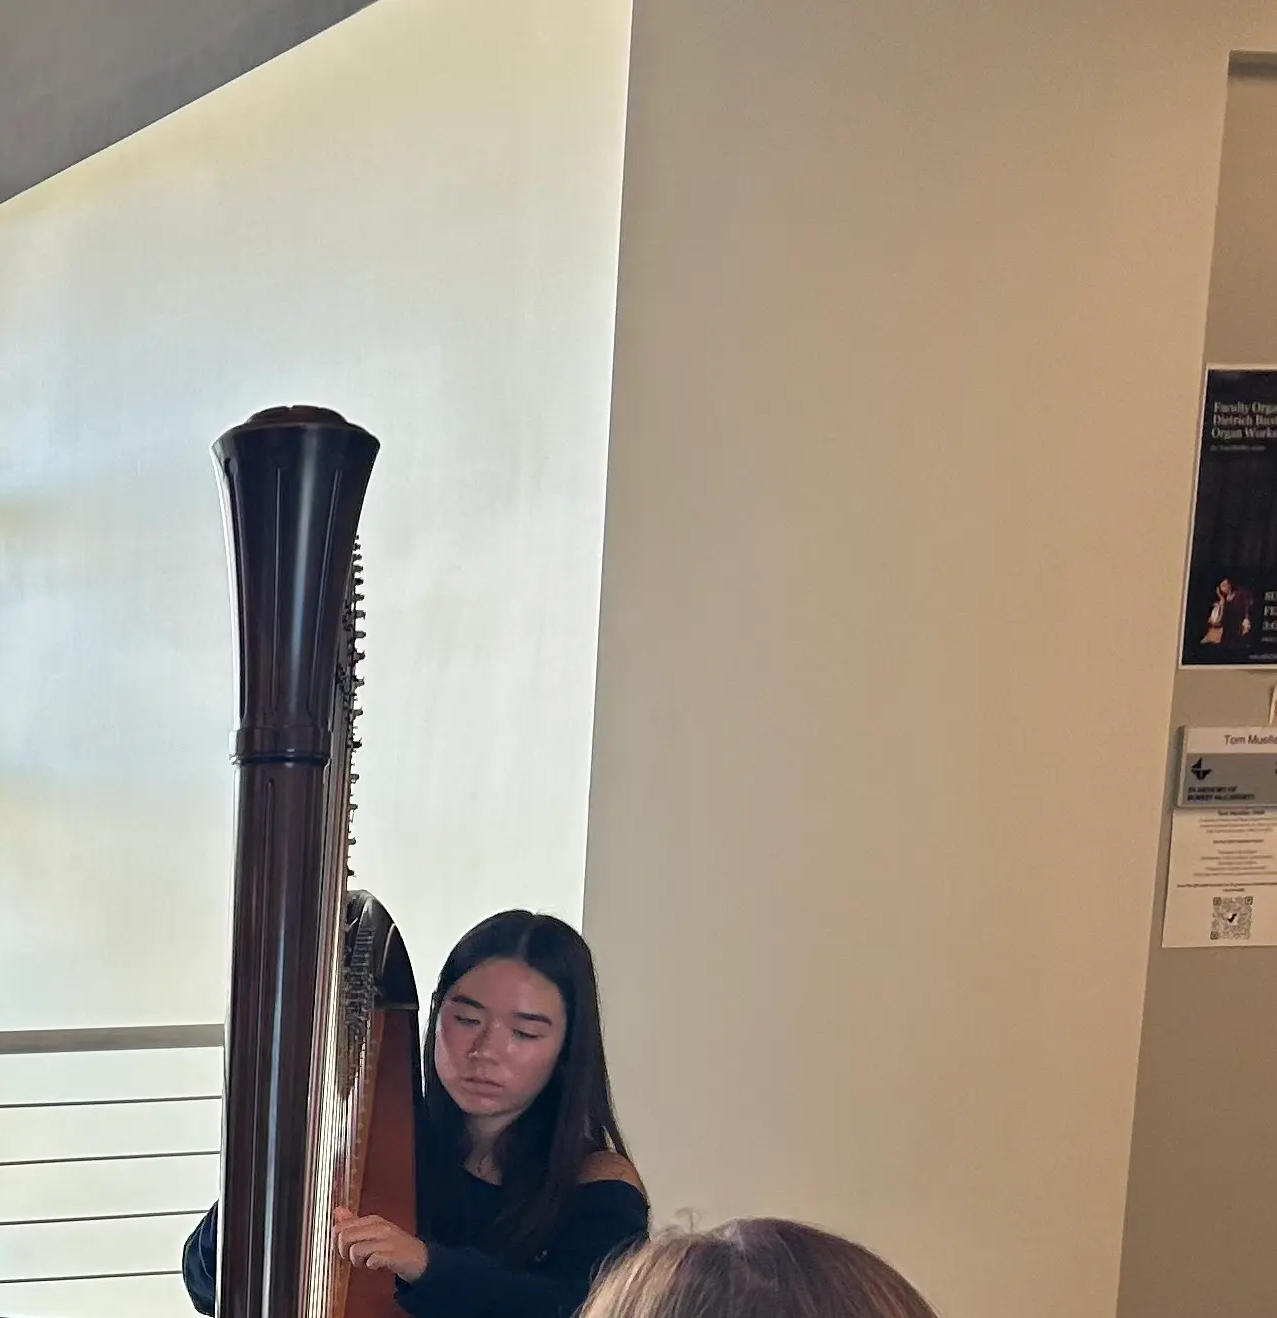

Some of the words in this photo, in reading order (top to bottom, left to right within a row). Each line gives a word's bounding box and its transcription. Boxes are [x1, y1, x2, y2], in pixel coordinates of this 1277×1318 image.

[1214, 401, 1250, 415] Faculty
[1213, 414, 1253, 426] Dietrich
[1211, 427, 1243, 440] Organ
[1224, 734, 1246, 745] Tom
